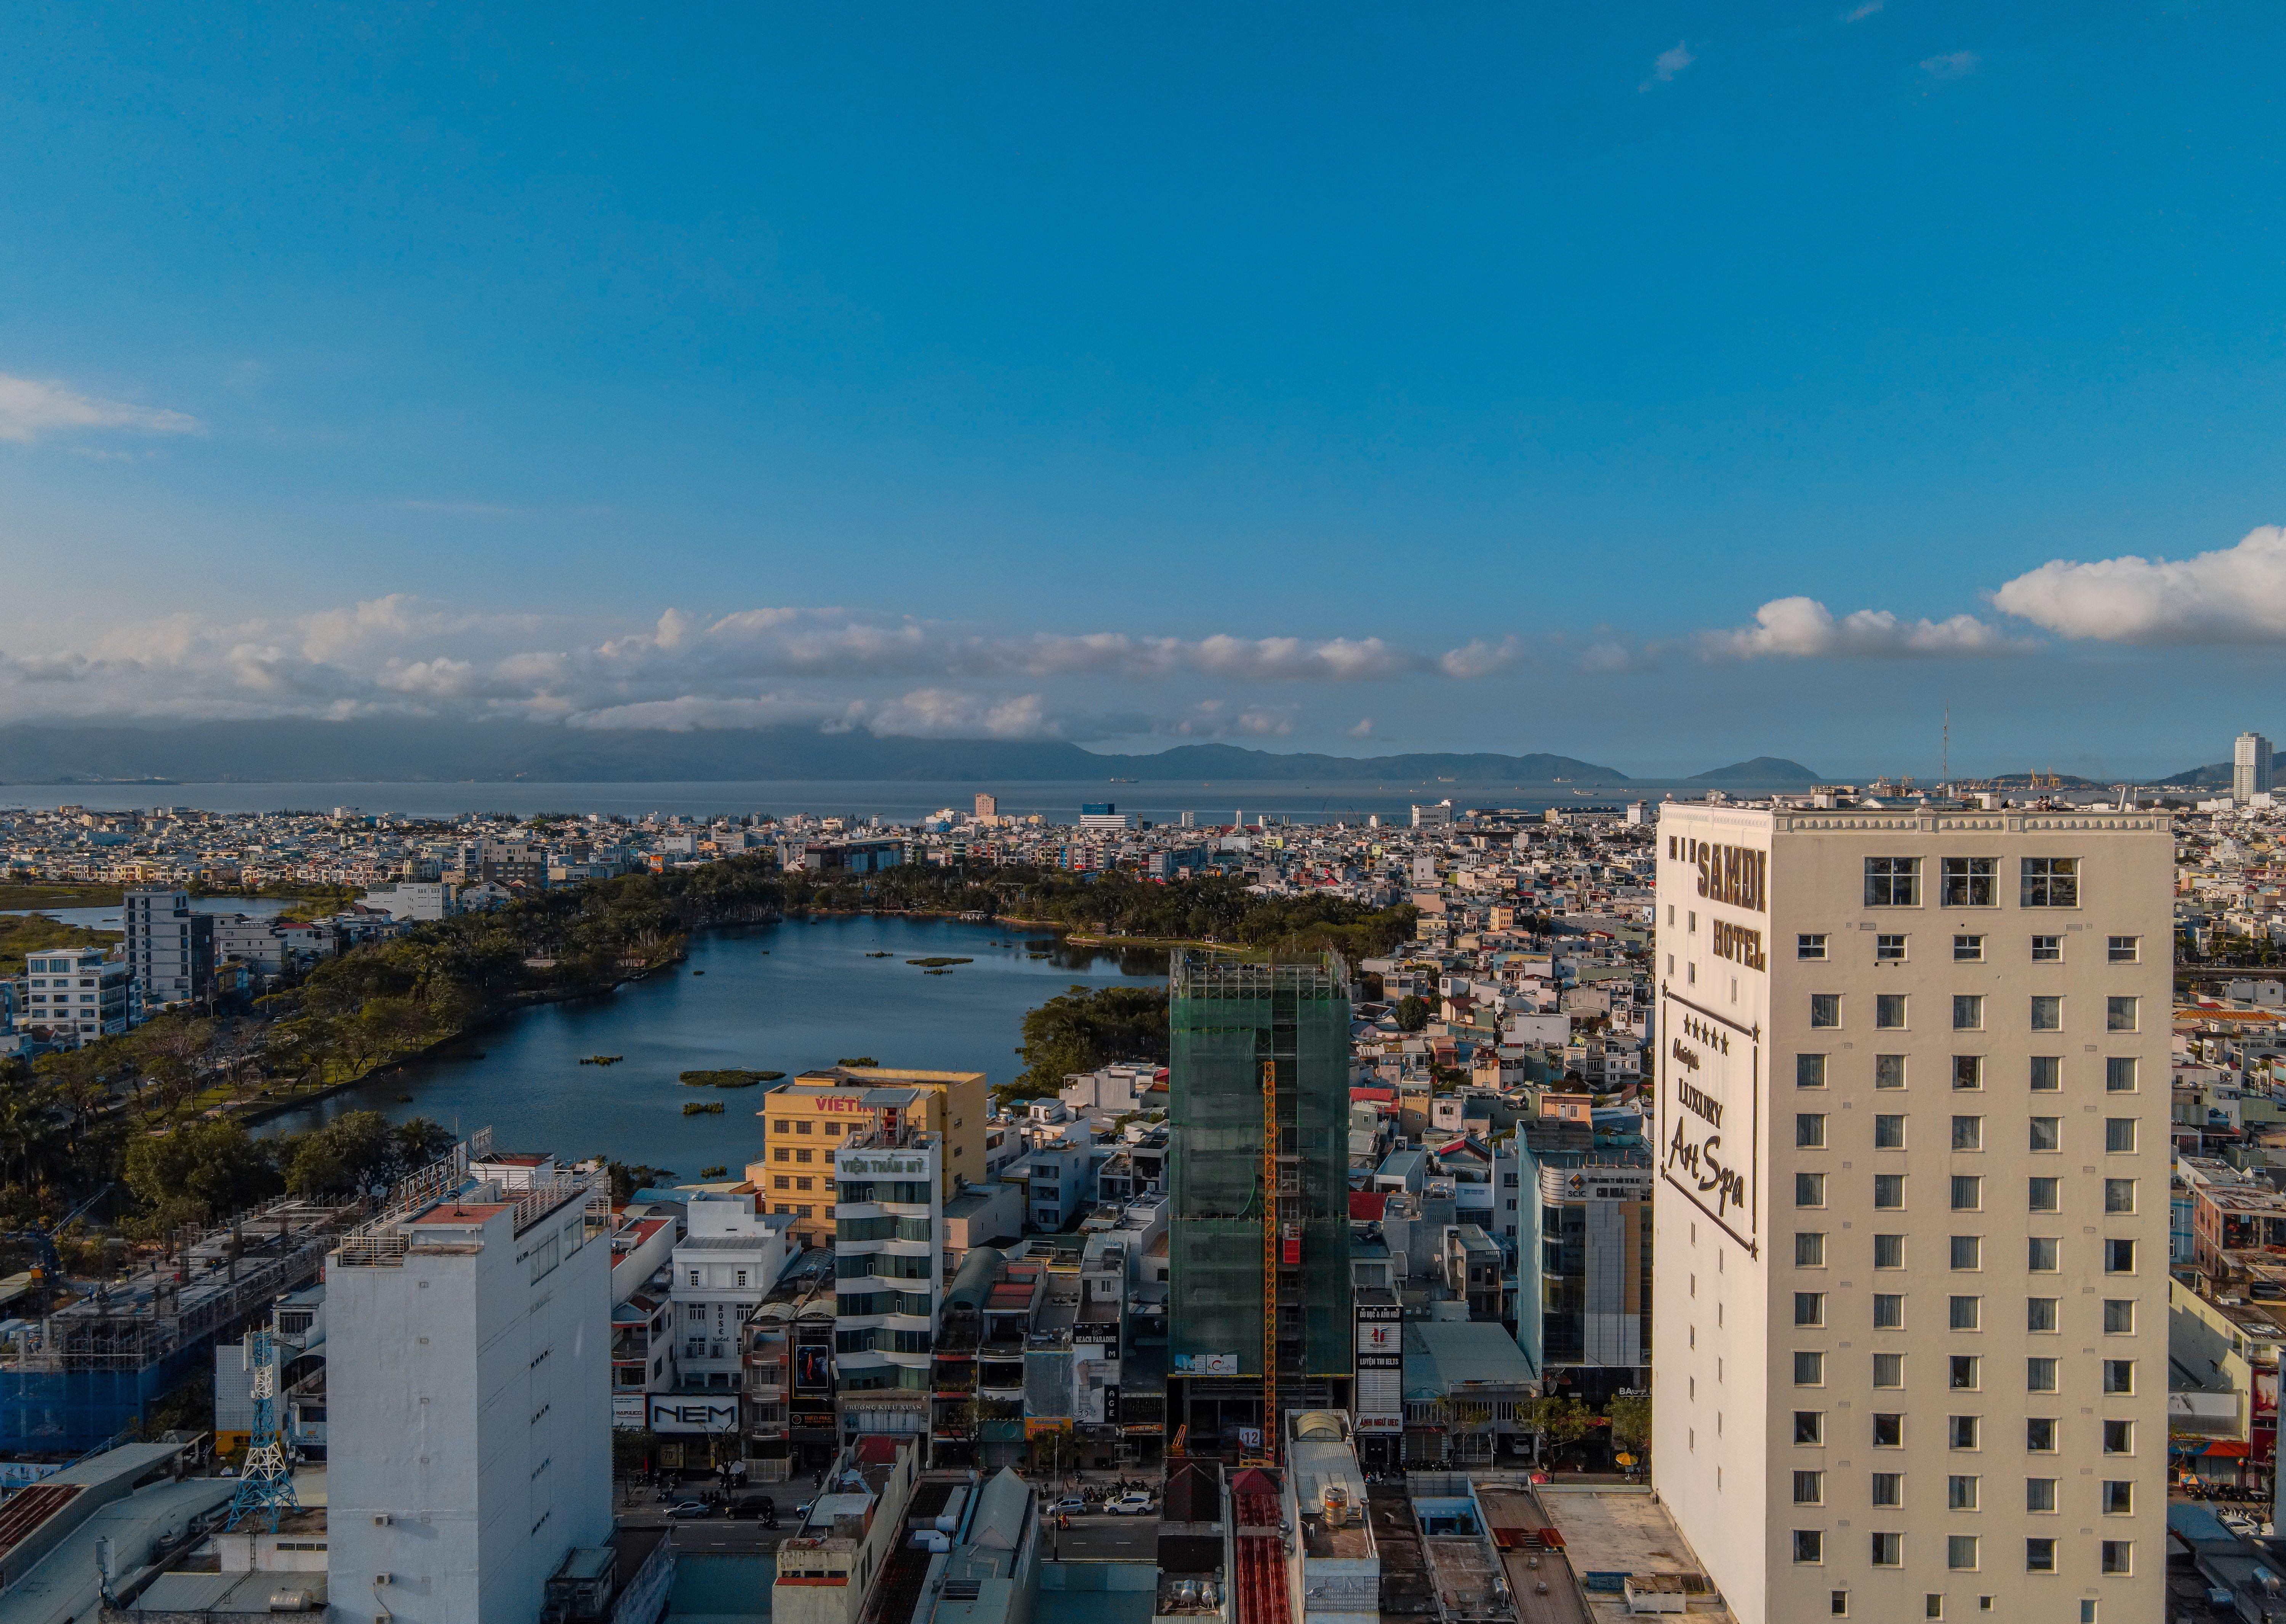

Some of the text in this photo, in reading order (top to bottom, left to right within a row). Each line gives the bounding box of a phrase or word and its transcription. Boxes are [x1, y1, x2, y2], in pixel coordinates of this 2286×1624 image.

[1697, 842, 1767, 913] SAMDI
[1713, 918, 1765, 973] HOTEL
[1678, 1078, 1723, 1129] LUXURY
[1668, 1116, 1743, 1217] Art Spa
[655, 1406, 734, 1422] NEM
